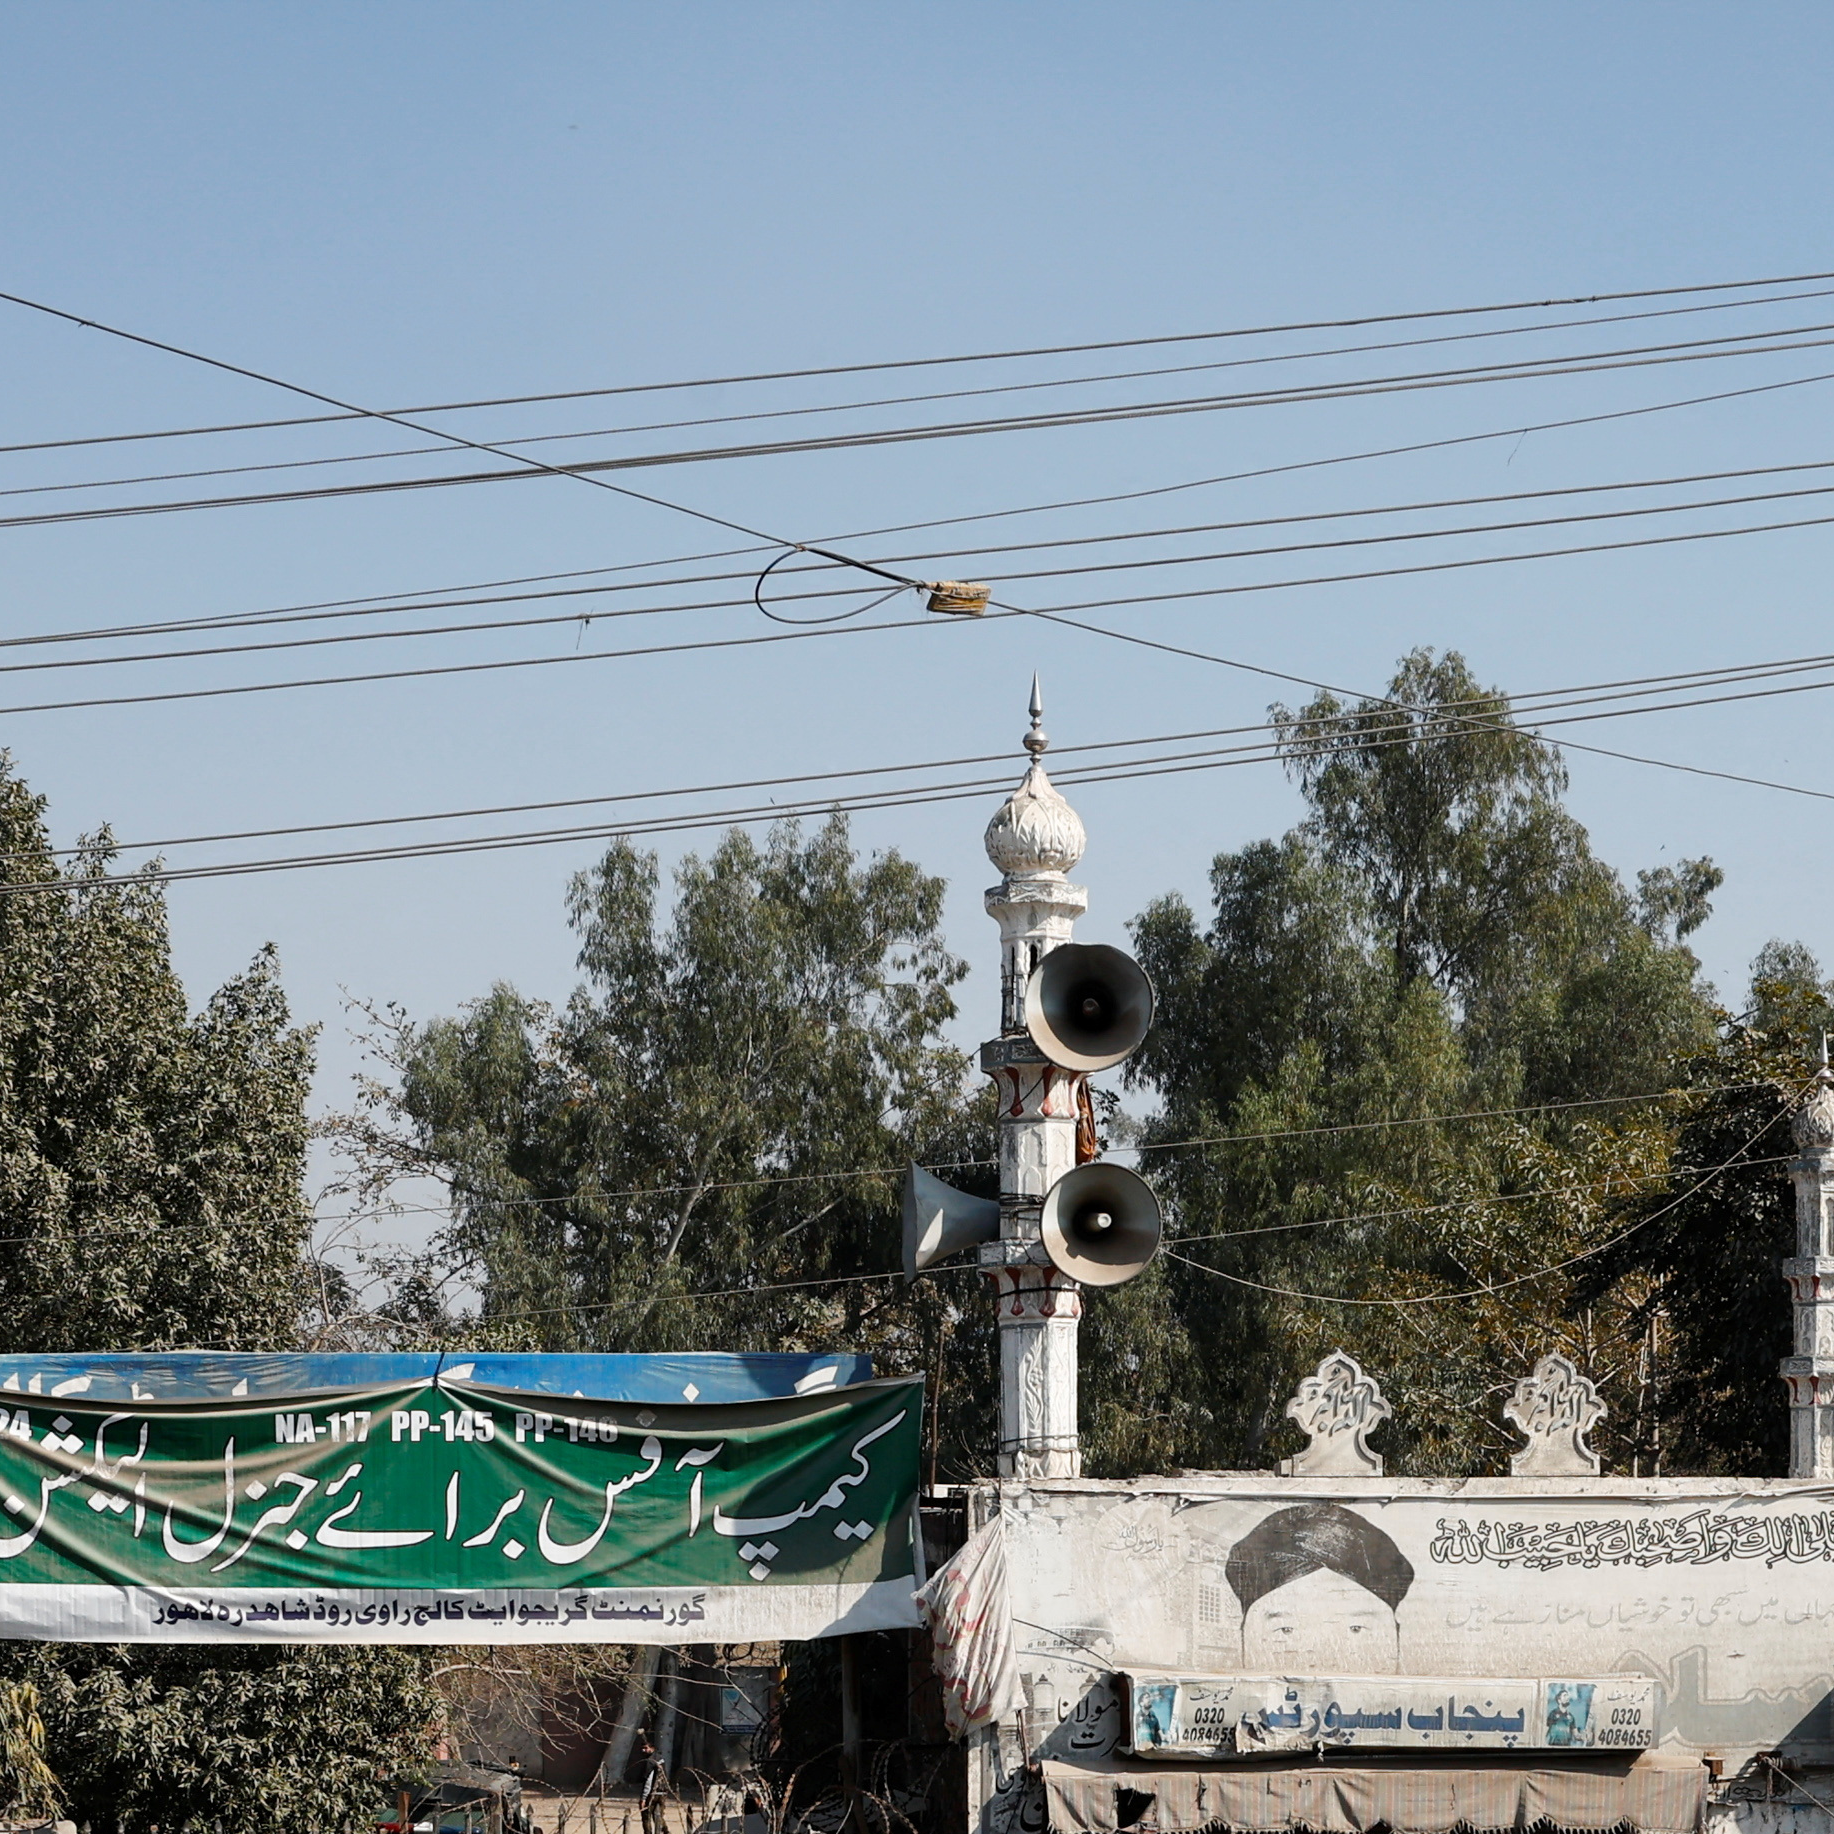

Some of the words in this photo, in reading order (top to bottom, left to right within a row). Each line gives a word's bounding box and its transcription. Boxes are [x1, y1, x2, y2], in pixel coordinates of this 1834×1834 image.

[275, 1410, 371, 1444] NA-117
[391, 1410, 494, 1443] PP-145
[515, 1412, 618, 1443] PP-146
[538, 1409, 724, 1565] آفس
[712, 1409, 908, 1581] کیمپ
[163, 1437, 319, 1573] جنرل
[316, 1463, 526, 1561] برائے
[152, 1600, 214, 1626] لاہور
[313, 1595, 353, 1626] روڈ
[355, 1600, 412, 1627] راوی
[413, 1598, 465, 1627] کالج
[591, 1593, 707, 1627] گورنمنٹ
[1195, 1707, 1225, 1724] 0320
[1241, 1687, 1402, 1745] سپورٹس
[1407, 1695, 1525, 1749] پنجاب
[1611, 1708, 1642, 1726] 0320
[1597, 1728, 1653, 1747] 4084655
